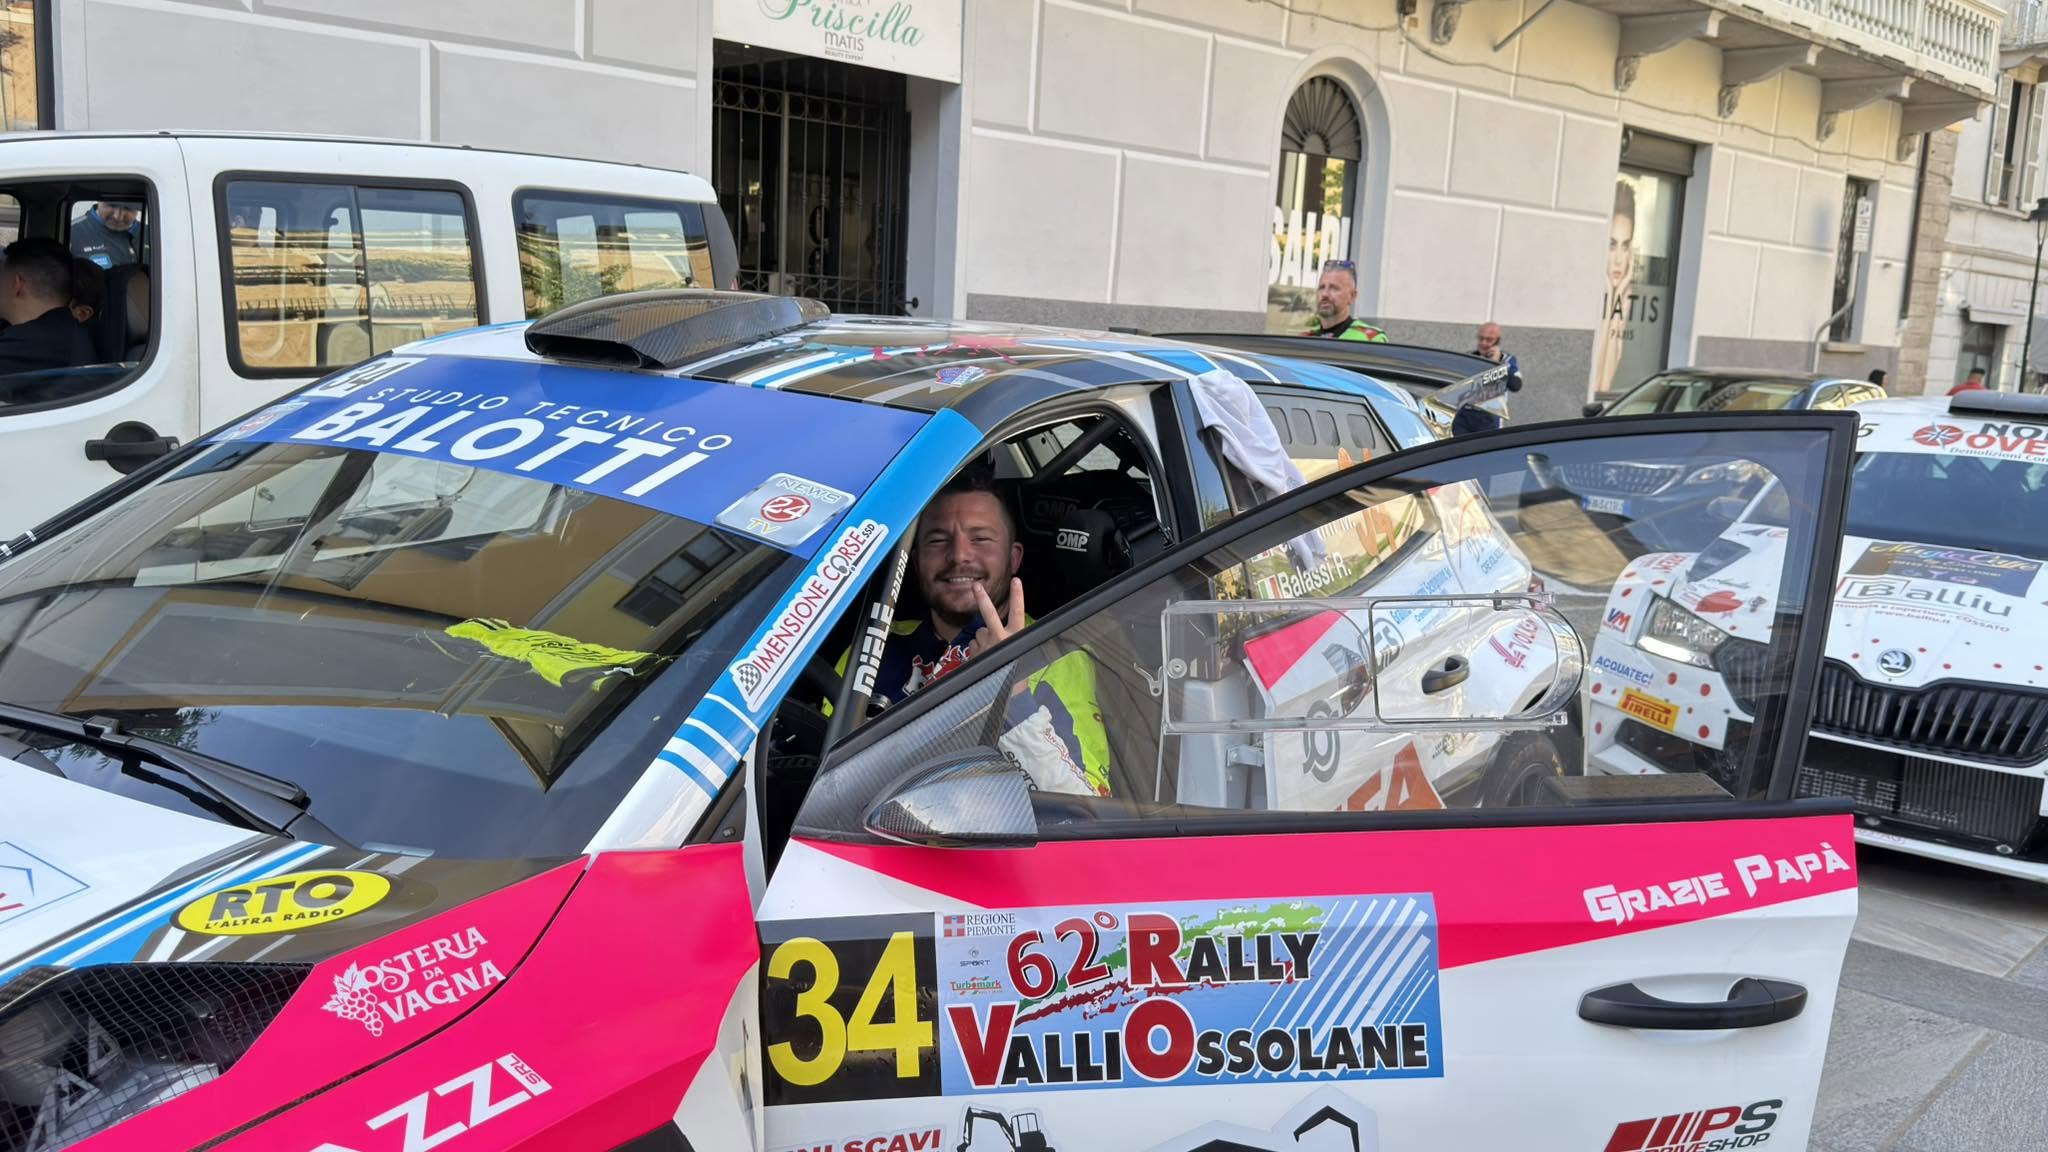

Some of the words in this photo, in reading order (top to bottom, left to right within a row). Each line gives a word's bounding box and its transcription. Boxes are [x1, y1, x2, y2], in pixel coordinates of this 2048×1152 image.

[824, 31, 864, 51] MATIS
[367, 387, 509, 410] STUDIO
[523, 401, 733, 450] TECNICO
[1979, 423, 2048, 441] NO
[290, 402, 711, 498] BALOTTI
[1949, 447, 2022, 460] Demolizioni
[775, 477, 842, 504] NEWS
[763, 496, 810, 521] 24
[746, 518, 784, 535] TV
[1056, 531, 1089, 549] OMP
[1278, 563, 1335, 598] Balassi
[1333, 552, 1352, 579] R.
[736, 580, 830, 696] DIMENSIONE
[822, 531, 867, 581] CORSE
[862, 523, 876, 539] SSD
[1857, 584, 2013, 617] Balliu
[1607, 608, 1632, 633] VM
[1622, 694, 1673, 725] PIRELLI
[208, 874, 355, 921] RTO
[1583, 872, 1730, 926] GRAZIE
[1734, 842, 1850, 898] PAPÀ
[204, 916, 273, 930] L'ALTRA
[283, 908, 345, 921] RADIO
[967, 913, 1016, 926] REGIONE
[967, 925, 1016, 936] PIEMONTE
[361, 927, 489, 993] OSTERIA
[960, 959, 991, 967] SPORT
[1006, 911, 1119, 1000] 62°
[1126, 912, 1321, 986] RALLY
[422, 967, 444, 982] DA
[950, 979, 1003, 991] Turbomark
[378, 960, 507, 1023] VAGNA
[767, 931, 933, 1086] 34
[509, 1053, 542, 1085] SRL
[309, 1053, 553, 1152] ZZI
[842, 1129, 942, 1152] SCAVI
